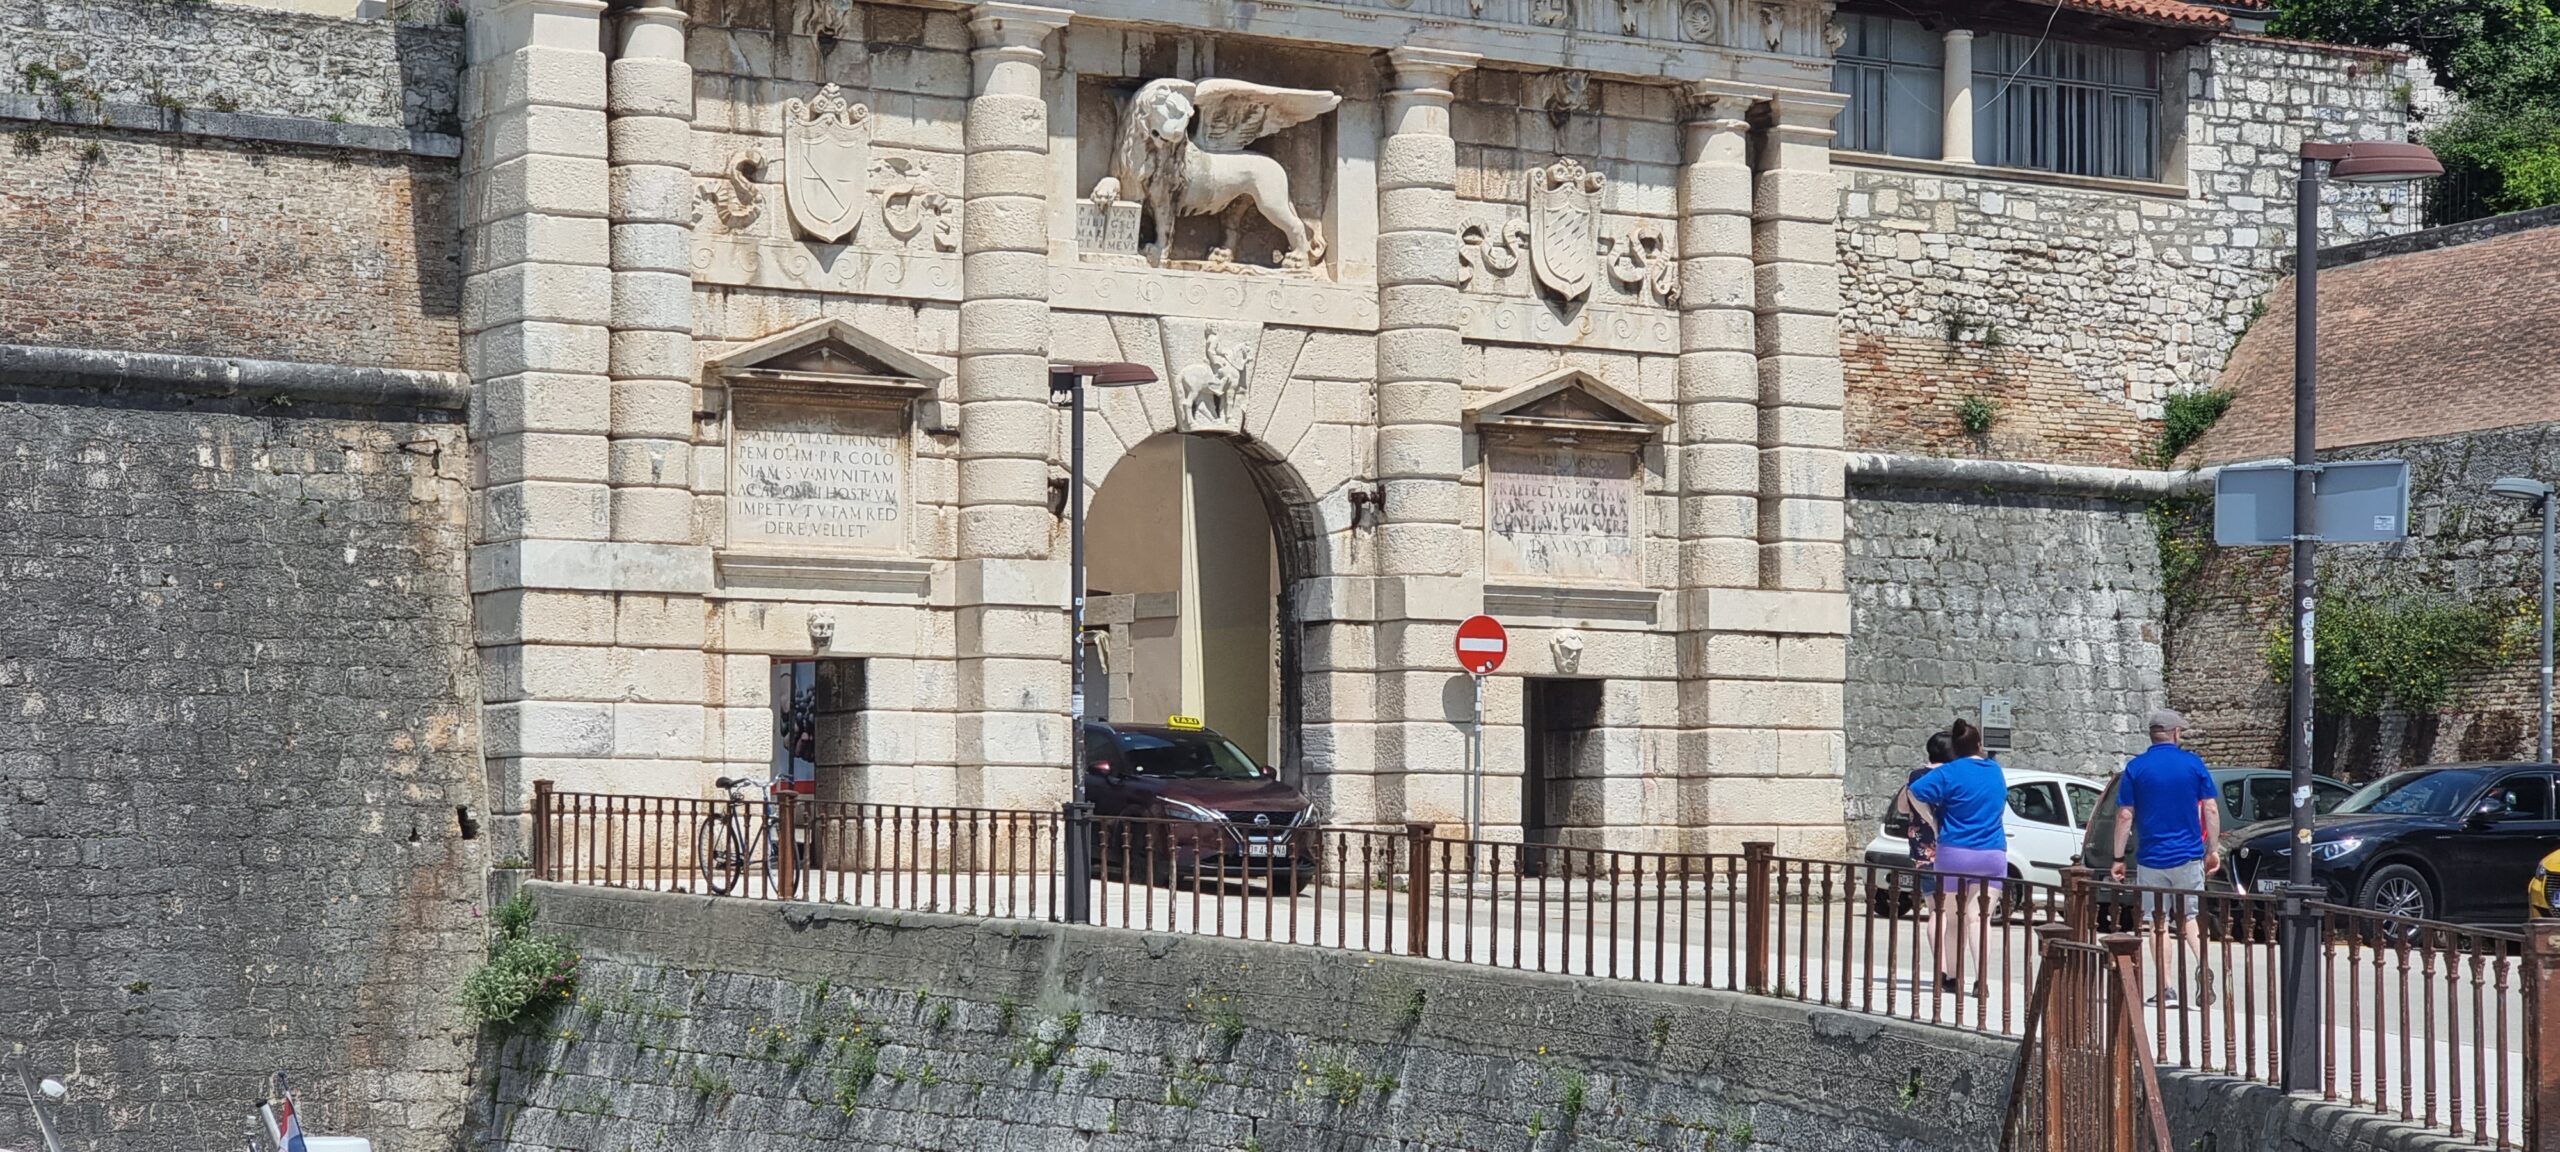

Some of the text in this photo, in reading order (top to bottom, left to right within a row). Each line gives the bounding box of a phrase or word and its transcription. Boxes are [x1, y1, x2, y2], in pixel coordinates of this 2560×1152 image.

[739, 446, 767, 460] PEM
[848, 452, 894, 465] COLO
[765, 521, 806, 535] DERE
